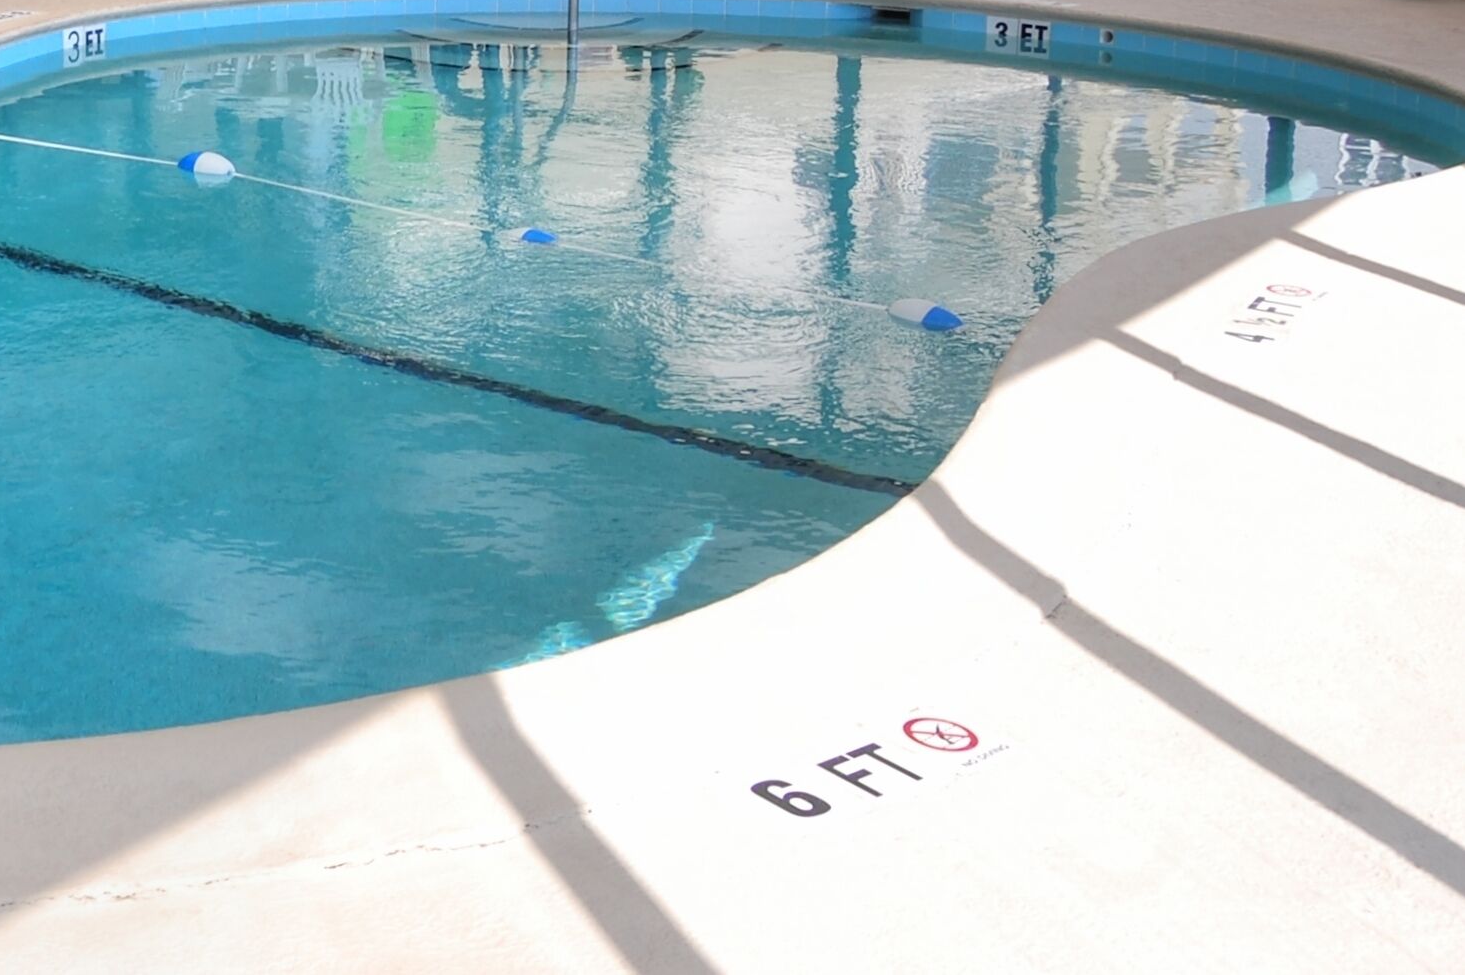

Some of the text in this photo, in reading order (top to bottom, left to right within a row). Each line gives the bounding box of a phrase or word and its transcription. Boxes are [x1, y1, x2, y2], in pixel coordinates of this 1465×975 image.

[67, 30, 80, 63] 3
[995, 22, 1008, 47] 3
[1247, 296, 1302, 317] FT
[1224, 331, 1275, 343] 4
[750, 779, 831, 817] 6
[816, 742, 924, 797] FT
